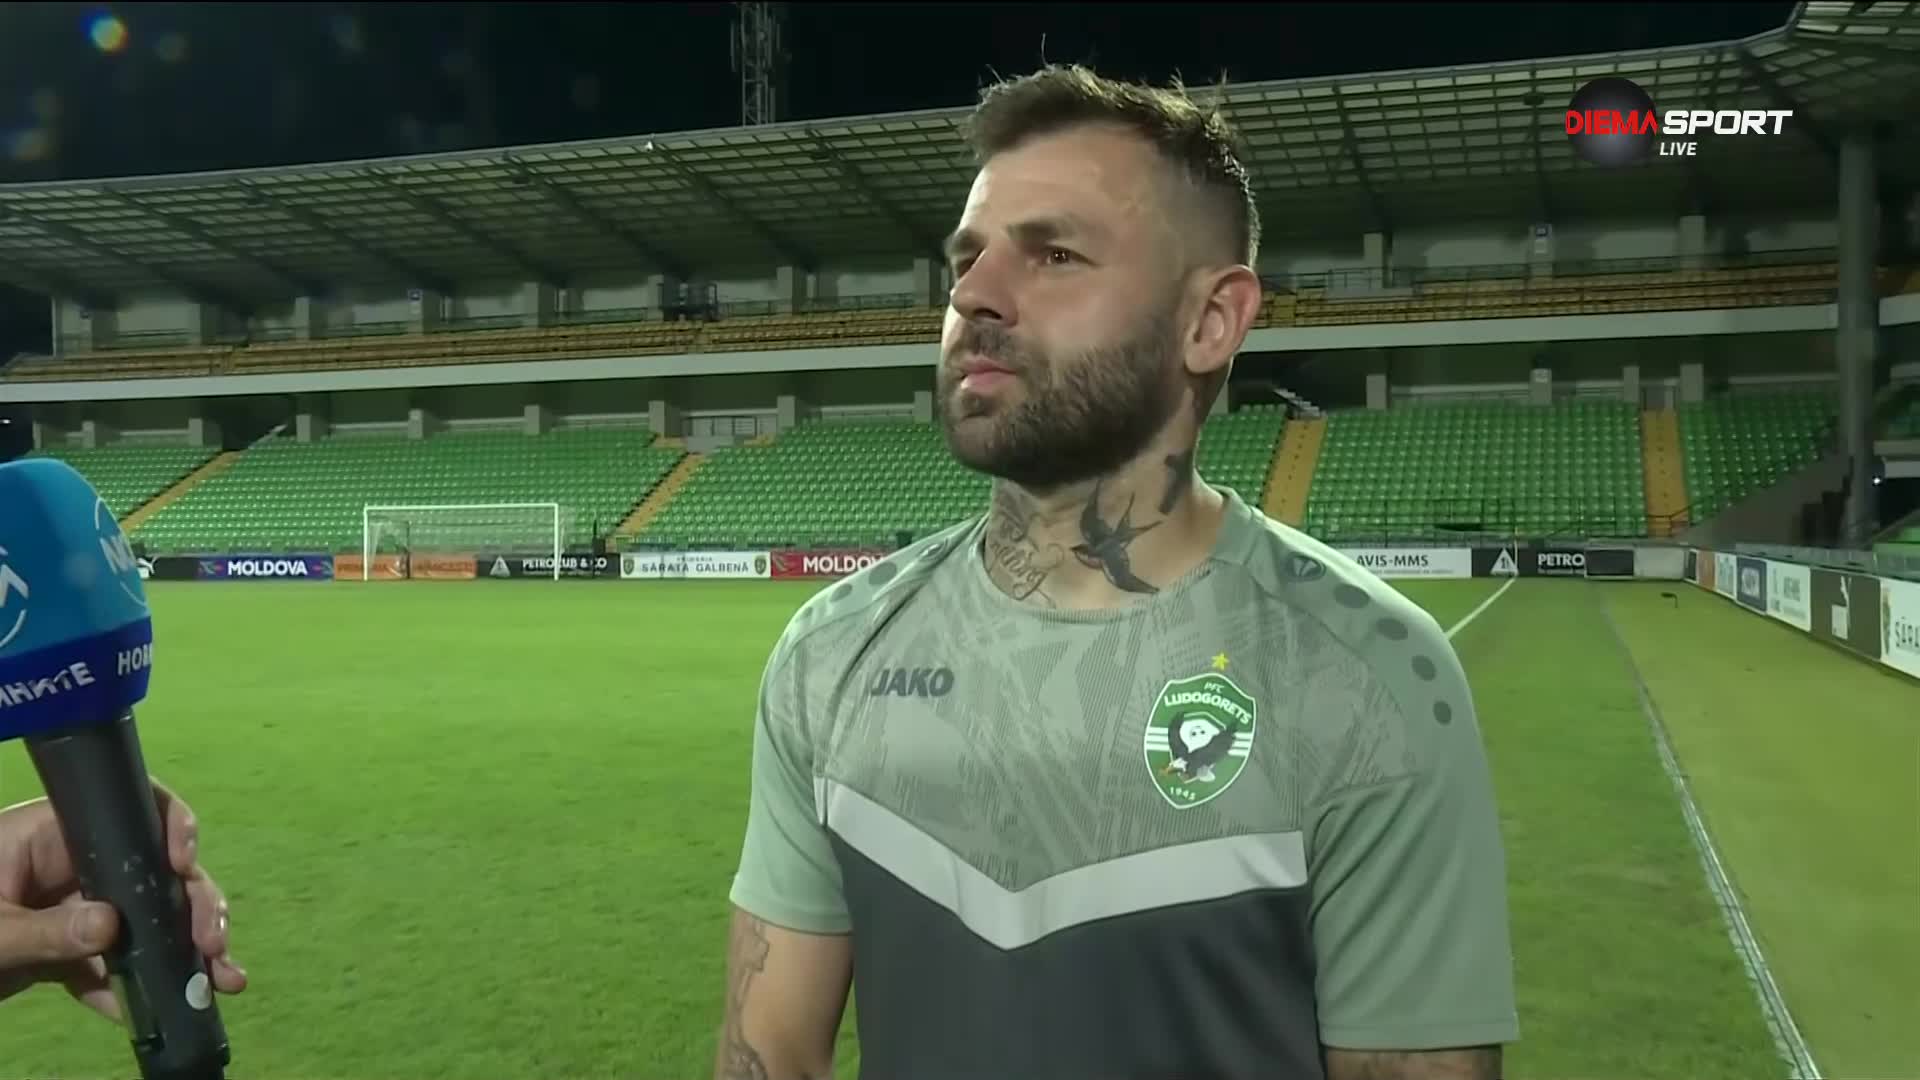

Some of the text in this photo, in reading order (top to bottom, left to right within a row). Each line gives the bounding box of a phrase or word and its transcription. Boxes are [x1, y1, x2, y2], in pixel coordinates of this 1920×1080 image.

[227, 560, 308, 576] MOLDOVA
[522, 557, 578, 569] PETROUB
[1356, 554, 1429, 567] AVIS-MMS
[870, 667, 955, 698] JAKO
[1203, 681, 1226, 694] PFC
[1163, 691, 1253, 725] LUDOGORETS
[1170, 786, 1197, 801] 1945
